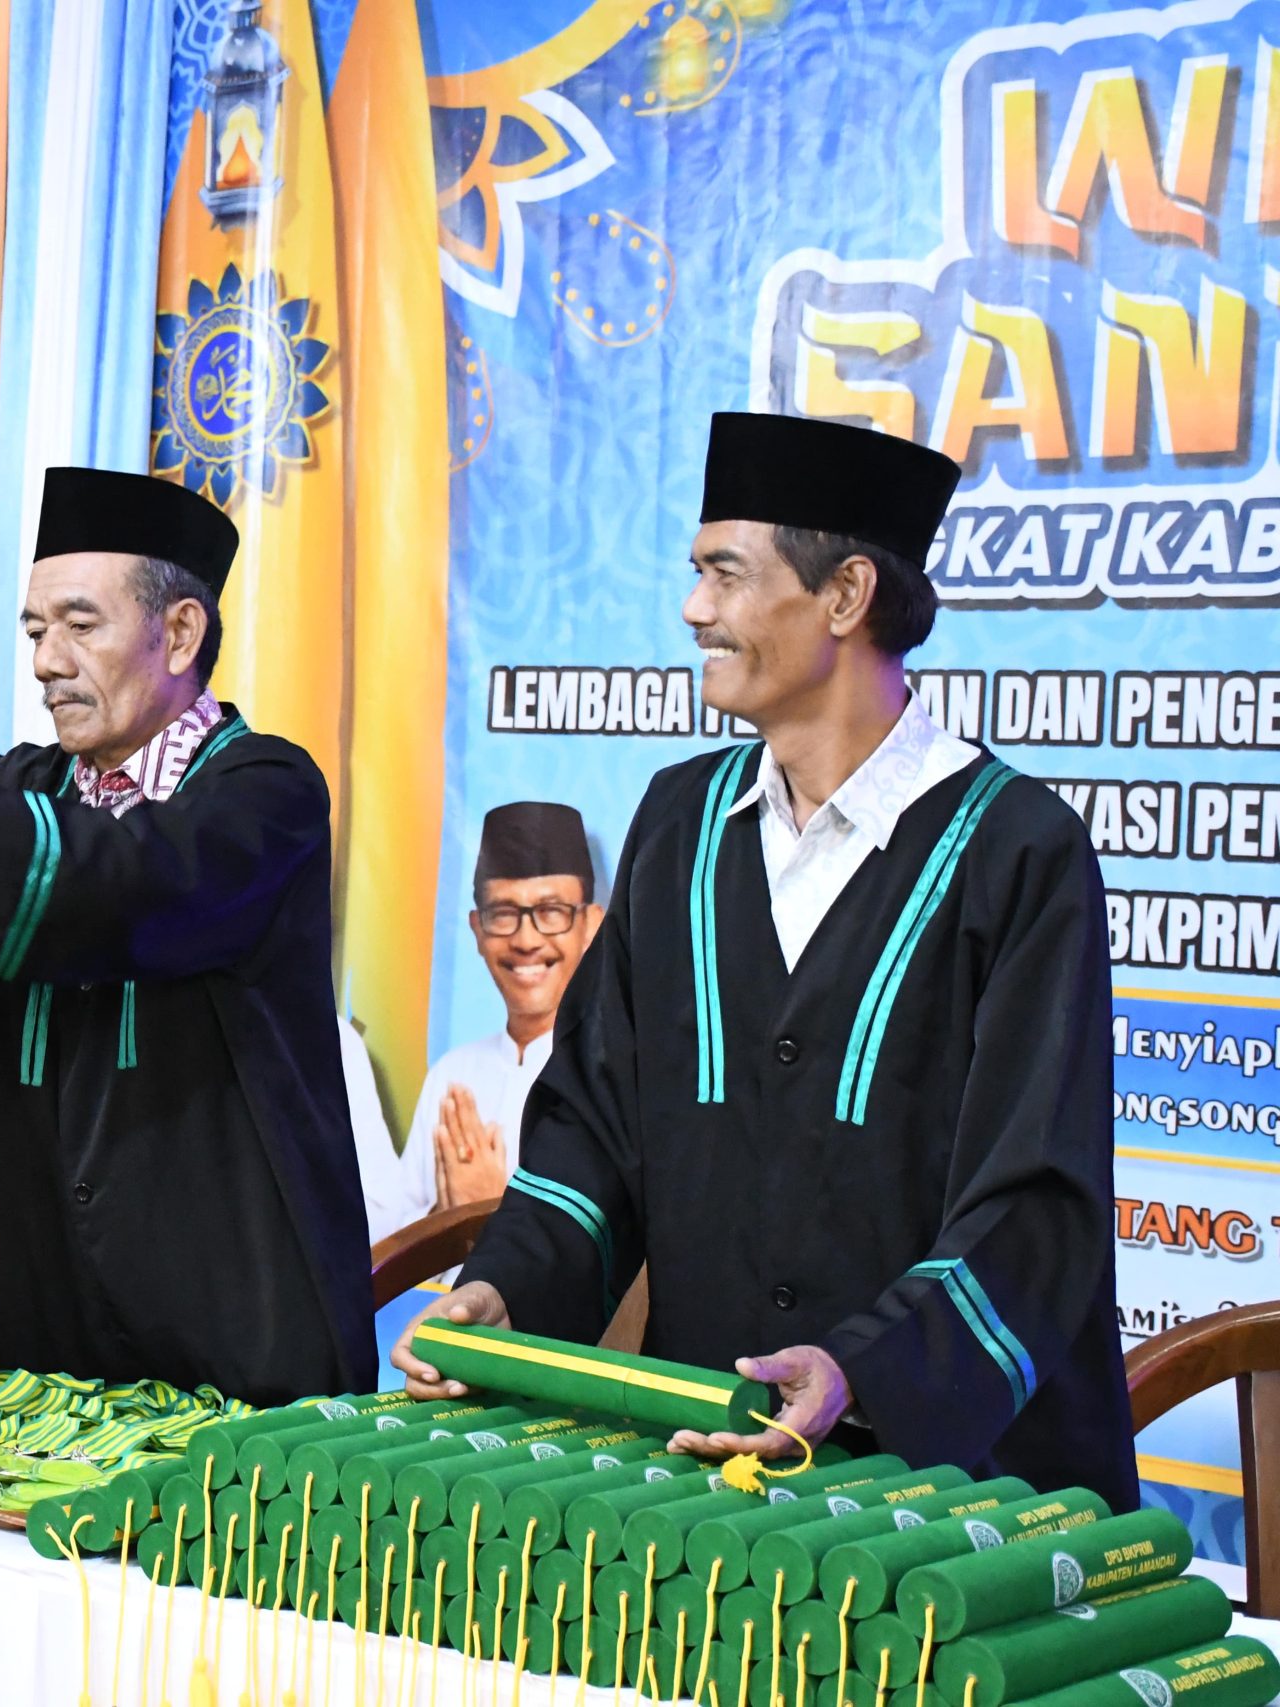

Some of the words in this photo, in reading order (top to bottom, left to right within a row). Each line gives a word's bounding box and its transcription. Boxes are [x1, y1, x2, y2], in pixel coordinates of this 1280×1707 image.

[490, 669, 692, 734] LEMBAGA
[995, 675, 1102, 742] DAN
[1115, 676, 1280, 746] PENGE
[1086, 1564, 1133, 1589] KABUPATEN
[1133, 1553, 1177, 1577] LAMANDAU
[1104, 1549, 1123, 1566] DPD
[1121, 1540, 1154, 1561] BKPRMI
[1170, 1665, 1222, 1693] KABUPATEN
[1218, 1653, 1265, 1679] LAMANDAU
